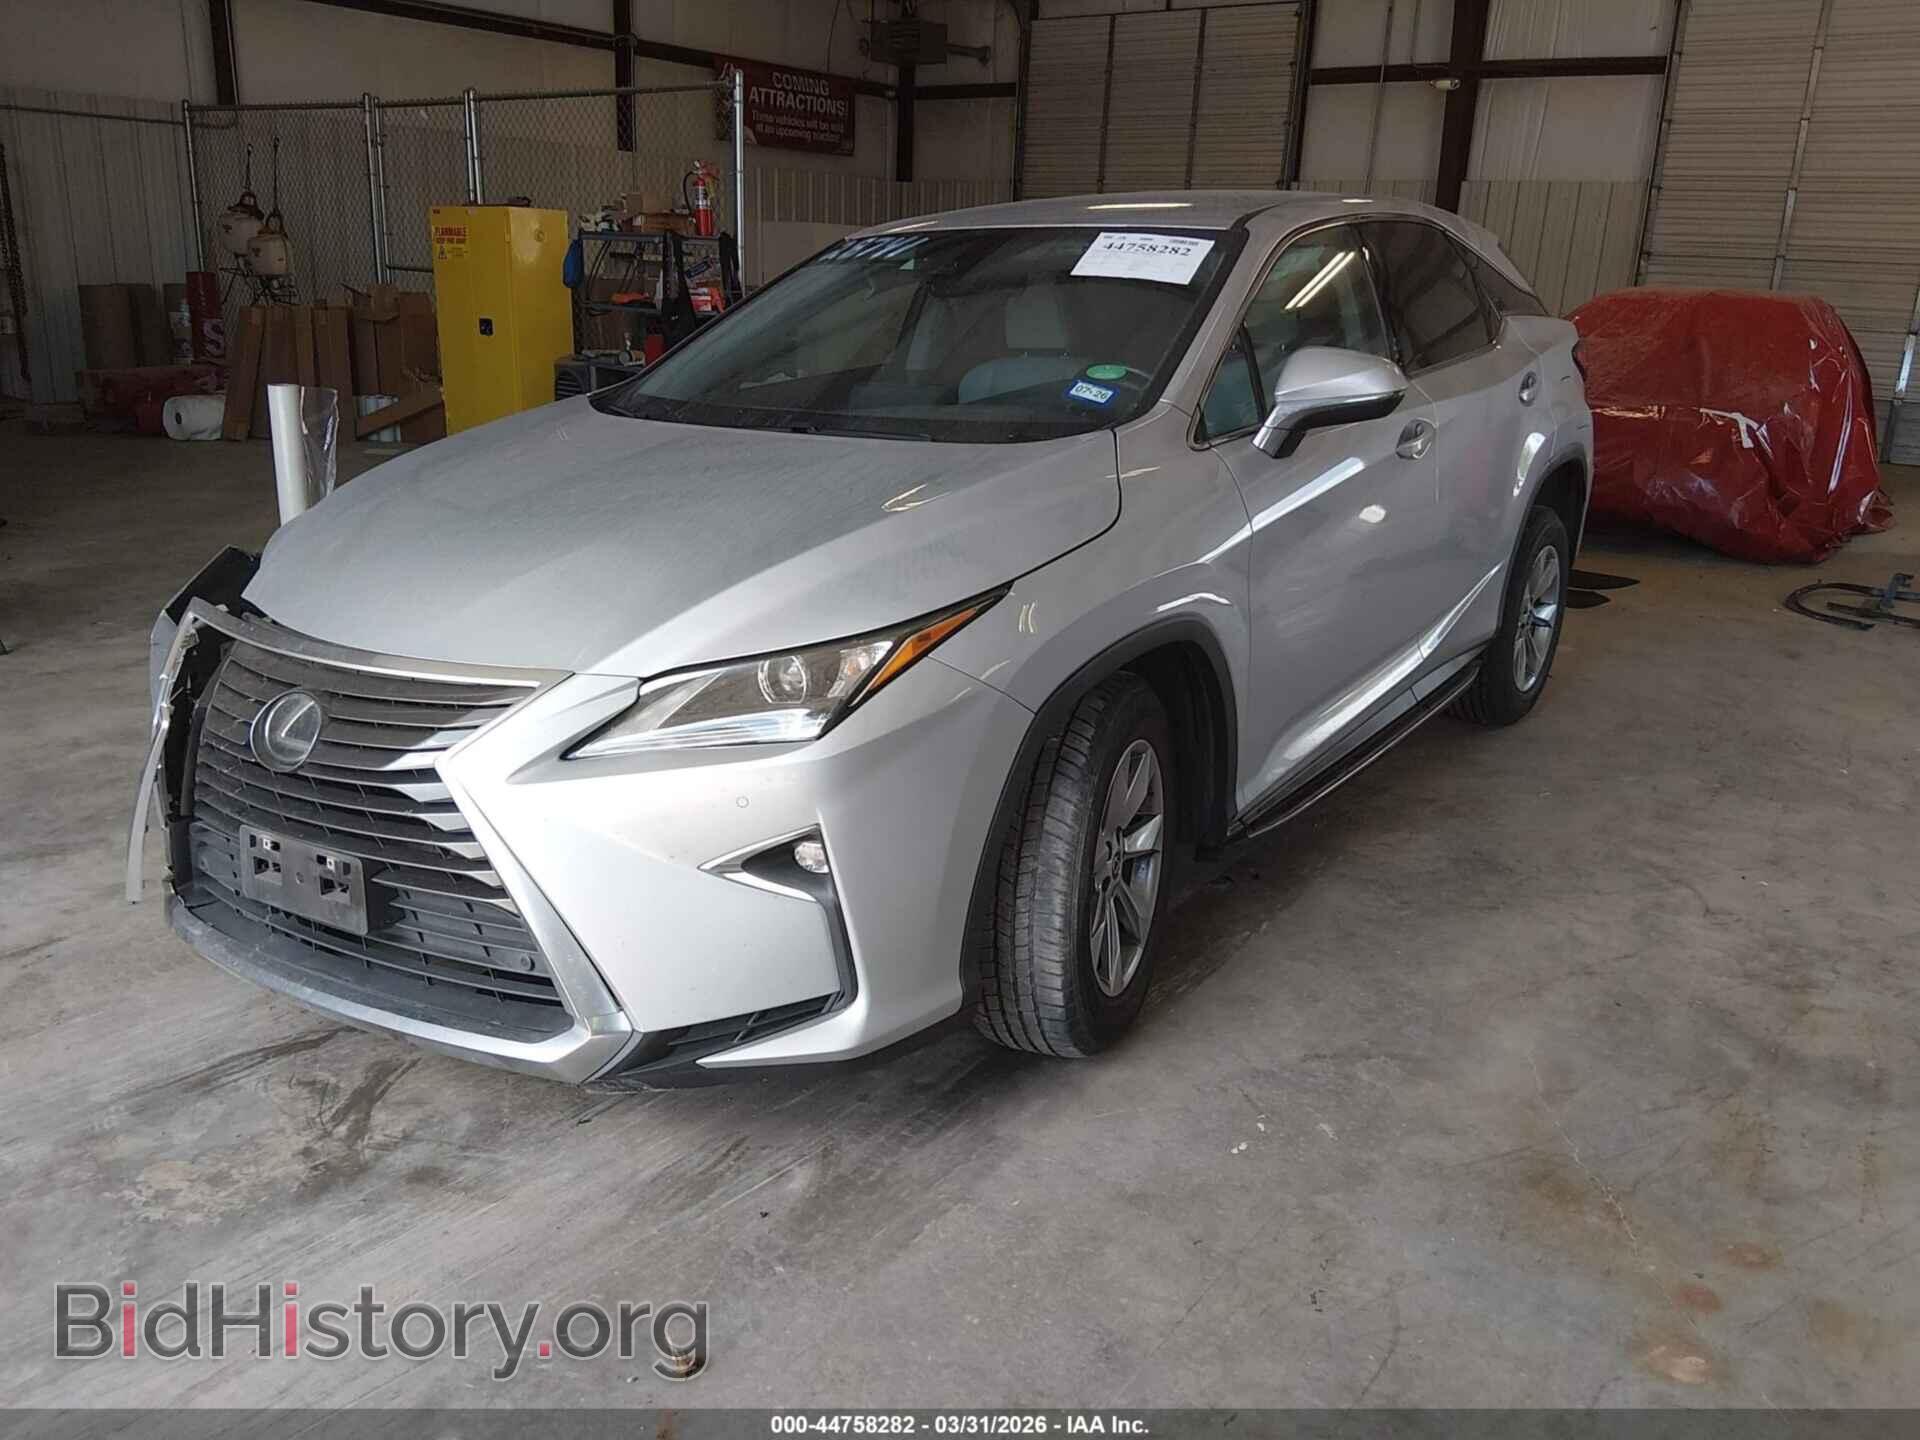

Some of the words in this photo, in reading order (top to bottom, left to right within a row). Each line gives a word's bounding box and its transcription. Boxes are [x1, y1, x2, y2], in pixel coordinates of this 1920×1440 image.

[772, 72, 829, 96] COMING
[750, 87, 848, 115] ATTRACTIONS!
[1103, 241, 1192, 257] 44758282
